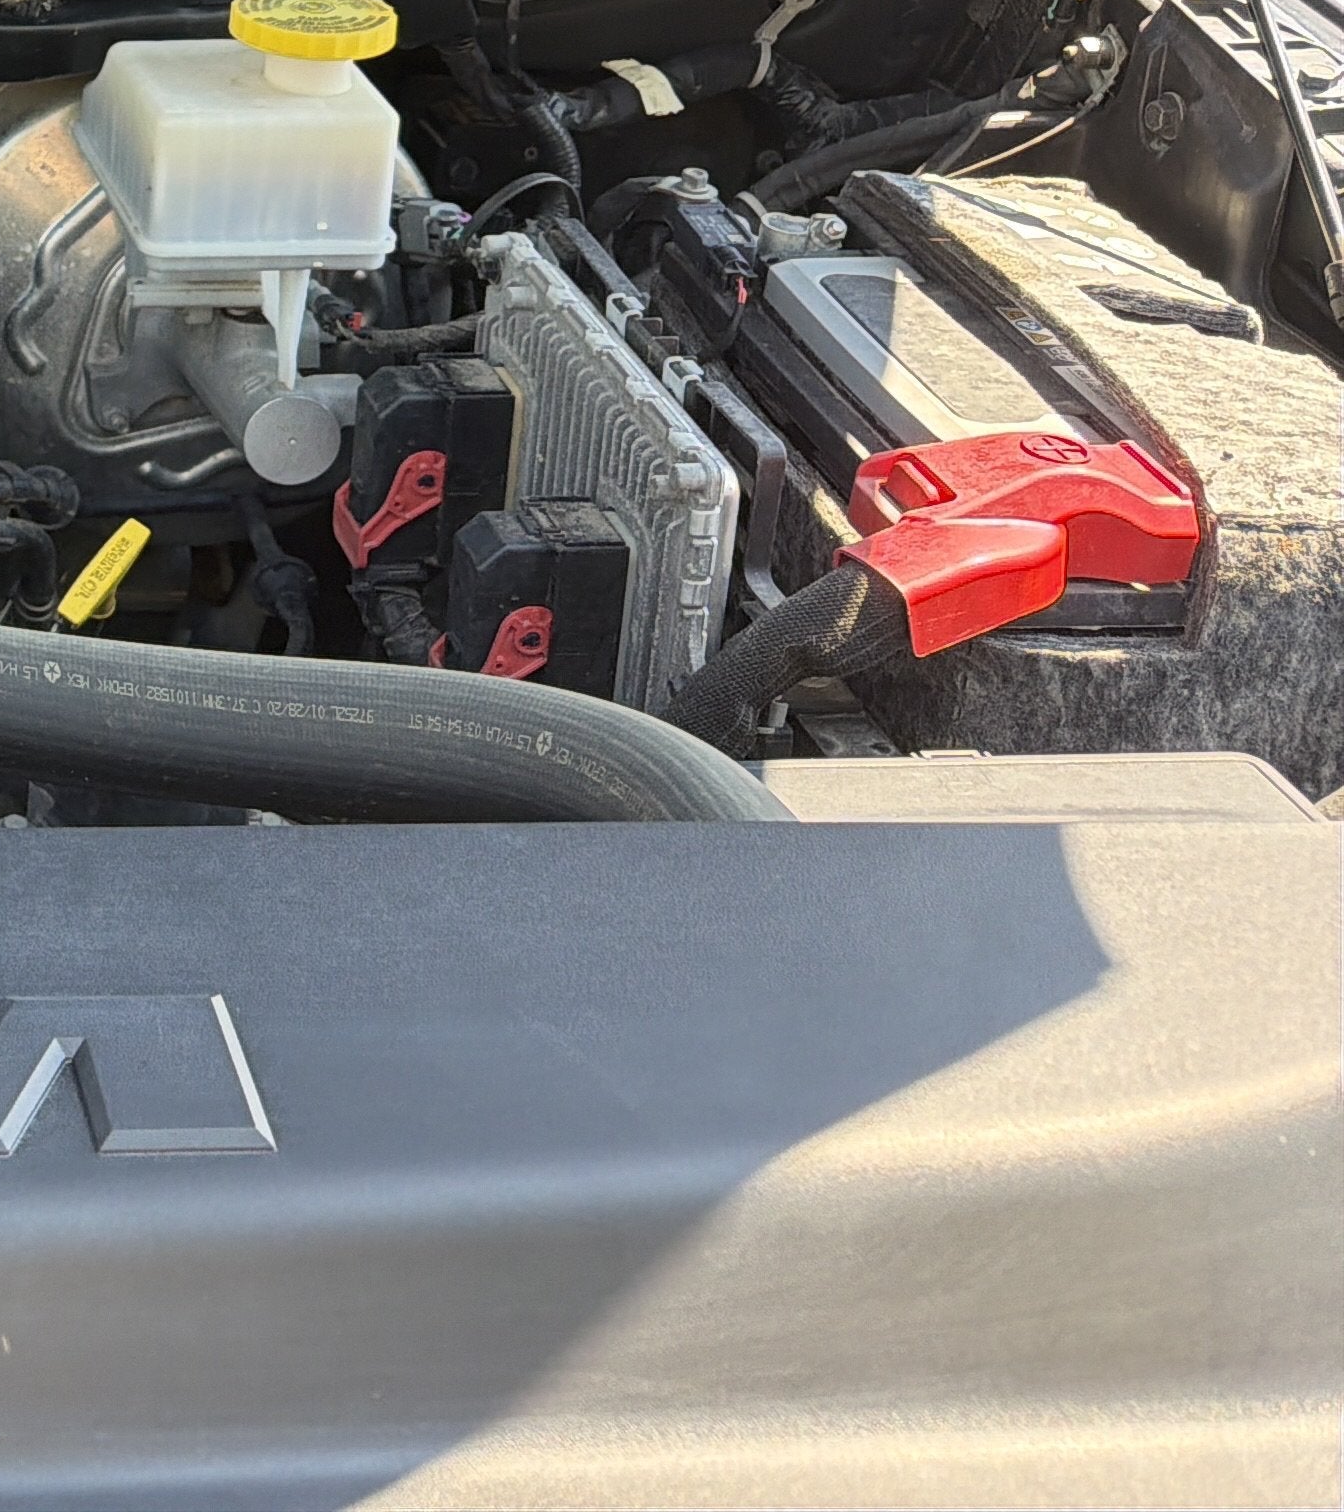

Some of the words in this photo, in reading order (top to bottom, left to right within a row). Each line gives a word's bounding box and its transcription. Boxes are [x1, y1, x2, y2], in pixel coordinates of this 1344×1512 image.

[74, 579, 97, 599] OIL
[67, 671, 91, 689] MEX
[267, 700, 326, 720] 01/28/20
